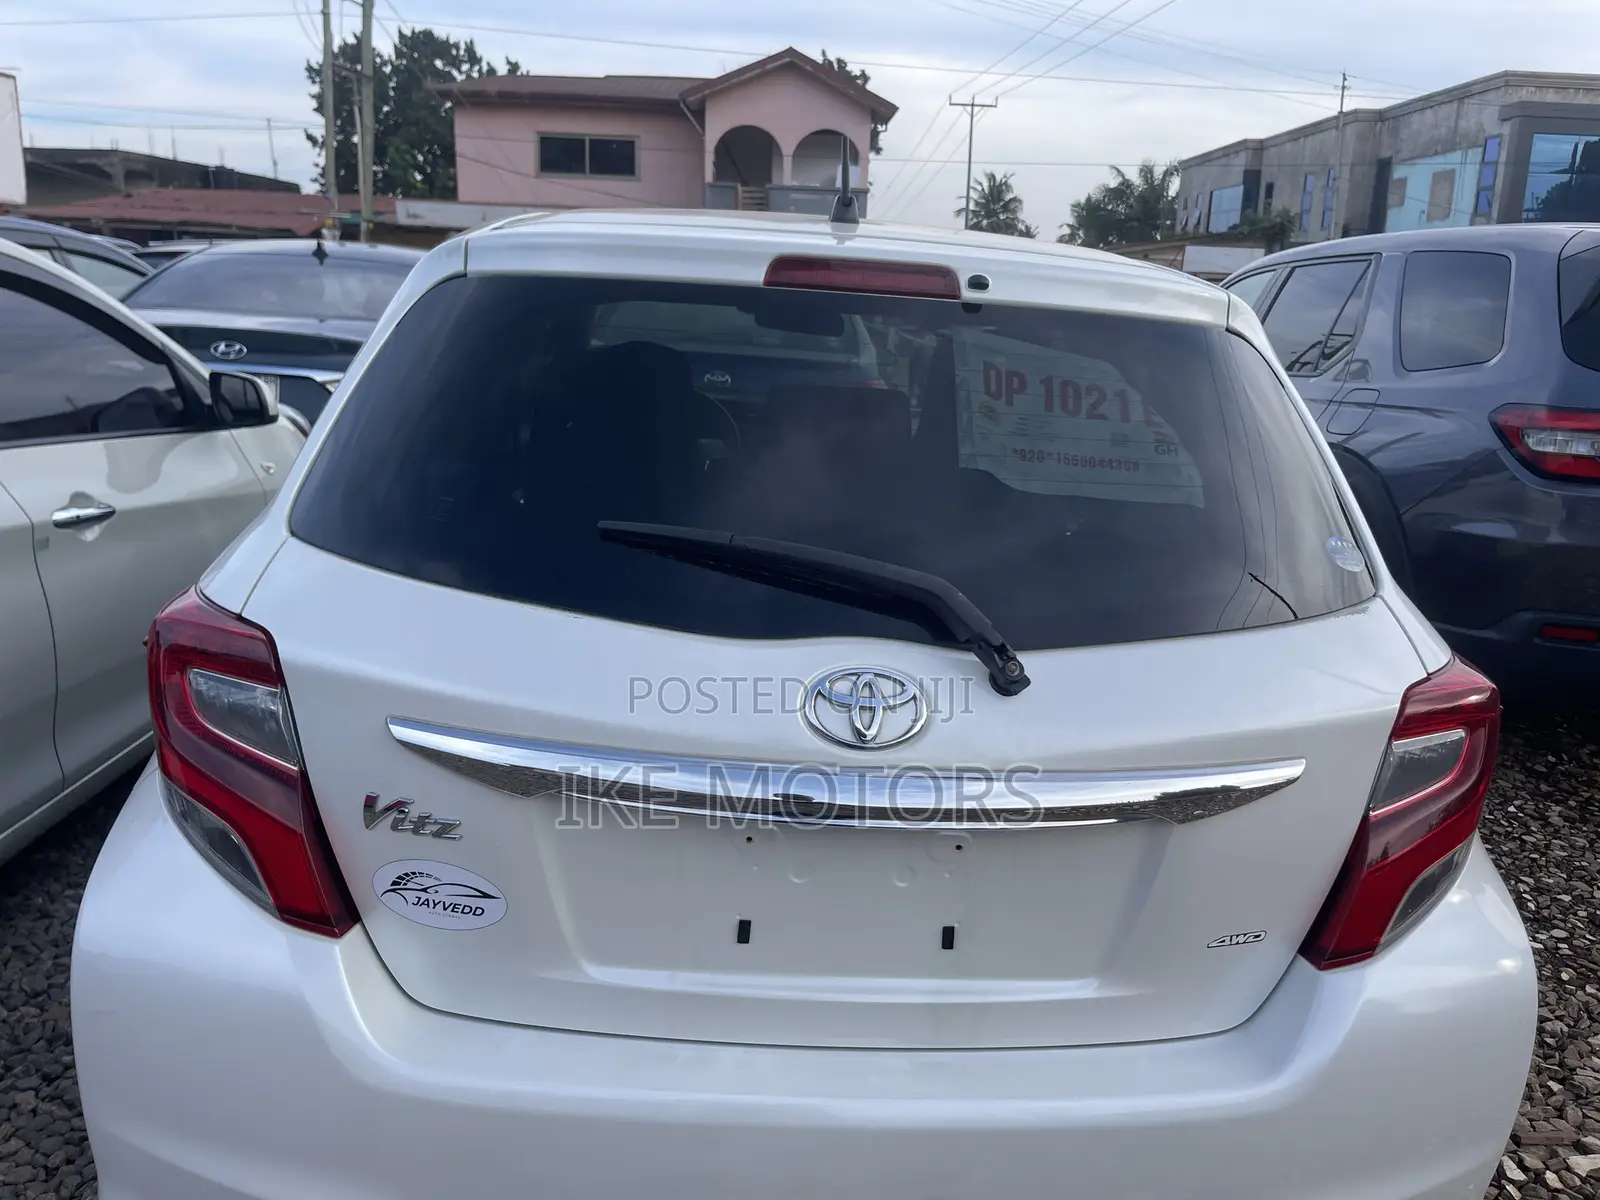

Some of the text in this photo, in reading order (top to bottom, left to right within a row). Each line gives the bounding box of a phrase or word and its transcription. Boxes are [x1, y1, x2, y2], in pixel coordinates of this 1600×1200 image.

[982, 360, 1028, 407] DP
[1039, 374, 1130, 423] 1021
[1154, 444, 1178, 457] GH
[363, 791, 464, 841] Vitz
[411, 896, 486, 918] JAYVEDD
